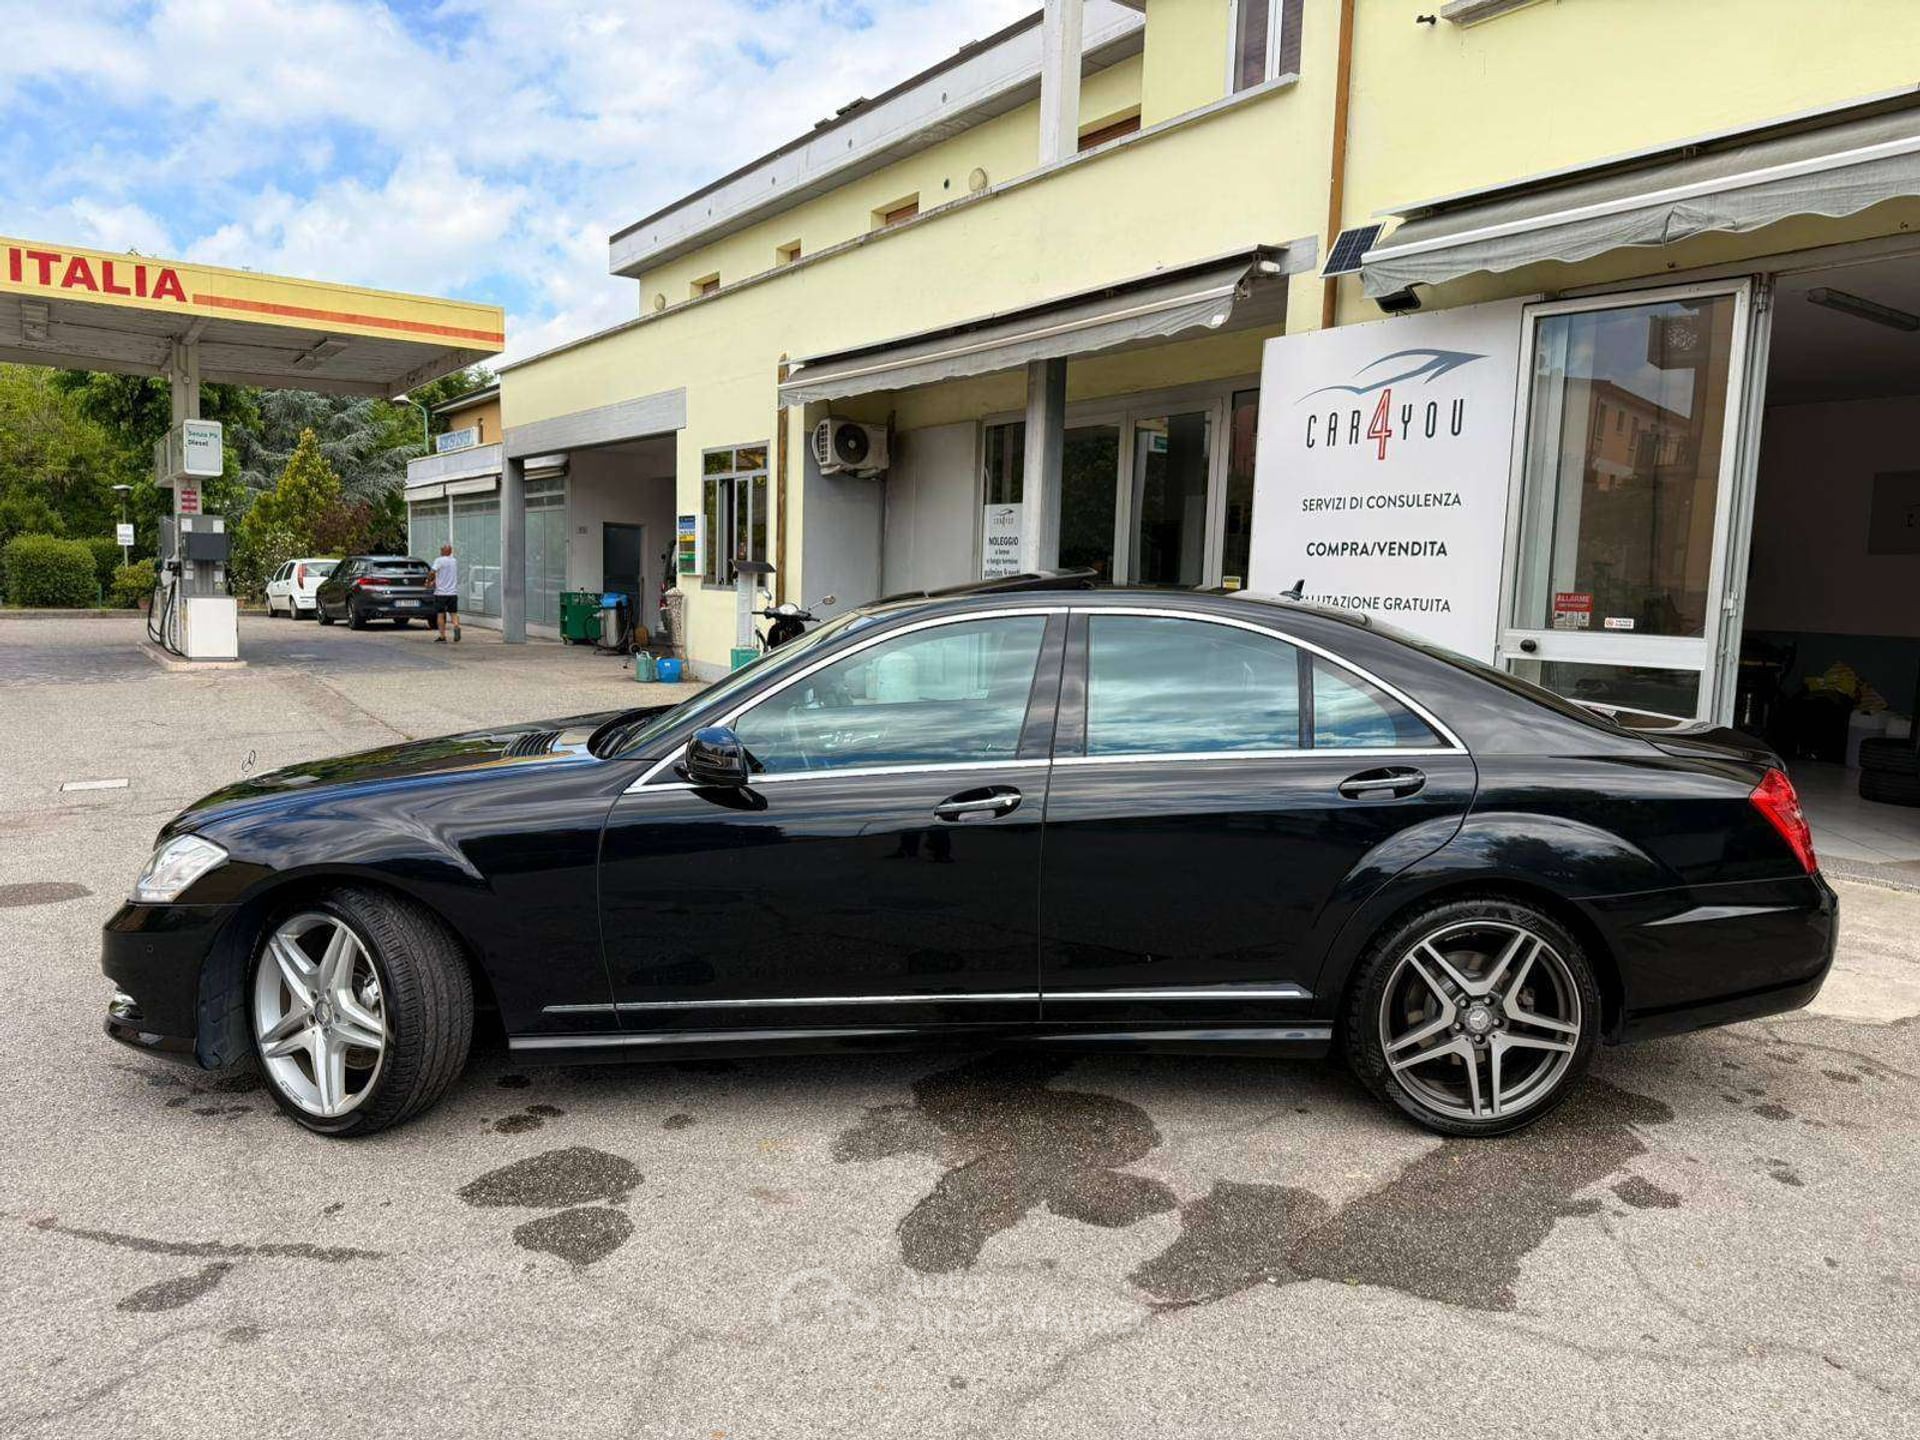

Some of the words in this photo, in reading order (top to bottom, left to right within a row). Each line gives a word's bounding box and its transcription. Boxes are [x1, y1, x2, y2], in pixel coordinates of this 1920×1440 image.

[9, 247, 188, 303] ITALIA
[188, 439, 209, 447] Diesel
[1302, 497, 1346, 512] SERVIZI
[1349, 496, 1364, 510] DI
[1367, 493, 1462, 509] CONSULENZA
[989, 536, 1019, 546] NOLEGGIO
[1306, 541, 1448, 557] COMPRA/VENDITA
[1383, 597, 1451, 612] GRATUITA
